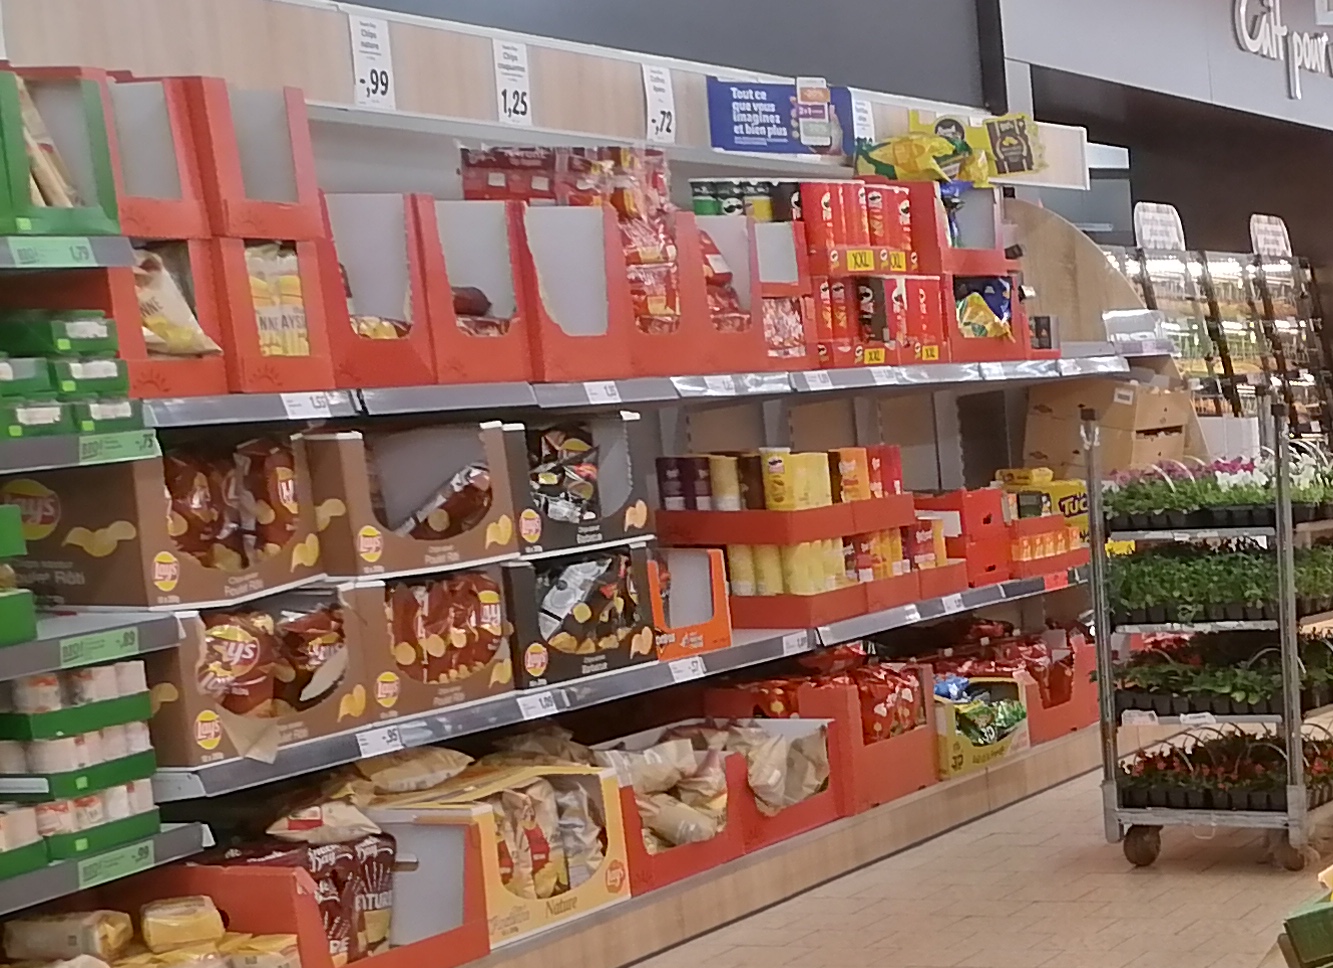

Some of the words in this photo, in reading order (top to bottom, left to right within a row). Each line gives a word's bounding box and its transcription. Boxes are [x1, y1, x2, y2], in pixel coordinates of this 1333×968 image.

[1289, 31, 1328, 99] pour
[359, 69, 389, 98] -,99
[731, 86, 753, 101] Tout
[754, 89, 767, 101] ce
[501, 89, 528, 118] 1,25
[732, 102, 749, 116] que
[750, 101, 776, 114] vous
[732, 111, 781, 126] imaginez
[733, 122, 745, 135] et
[745, 123, 766, 136] bien
[766, 125, 788, 140] plus
[853, 252, 870, 268] XXL
[545, 897, 579, 919] Nature
